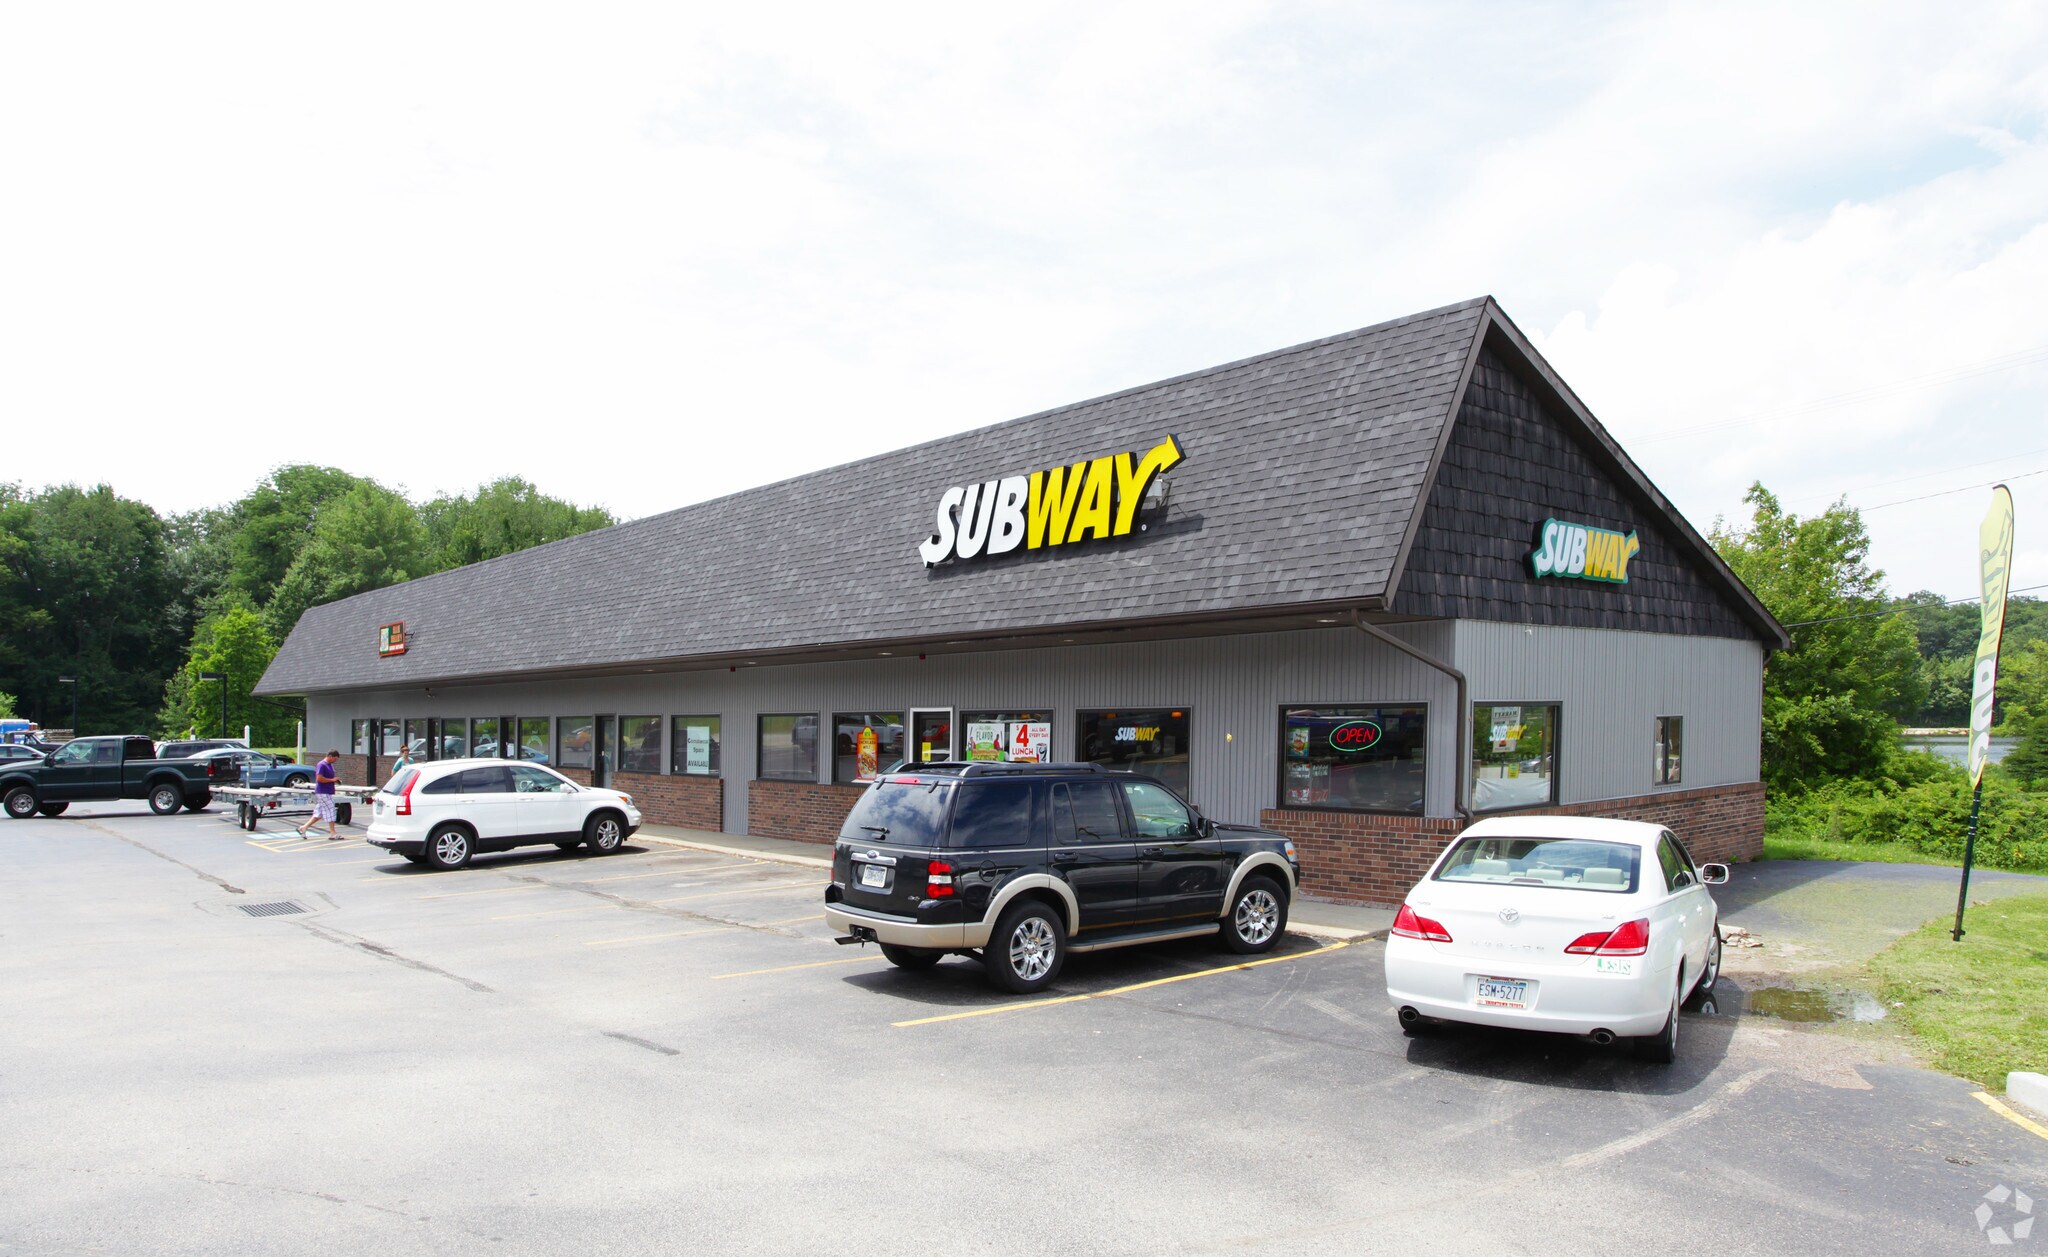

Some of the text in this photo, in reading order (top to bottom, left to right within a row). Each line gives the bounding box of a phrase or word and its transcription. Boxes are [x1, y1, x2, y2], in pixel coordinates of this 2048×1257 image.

[918, 433, 1187, 568] SUBWAY
[1535, 522, 1640, 580] SUBWAY
[976, 731, 993, 741] FLAVOR
[1115, 727, 1160, 741] SUBWAY
[1336, 728, 1375, 743] OPEN
